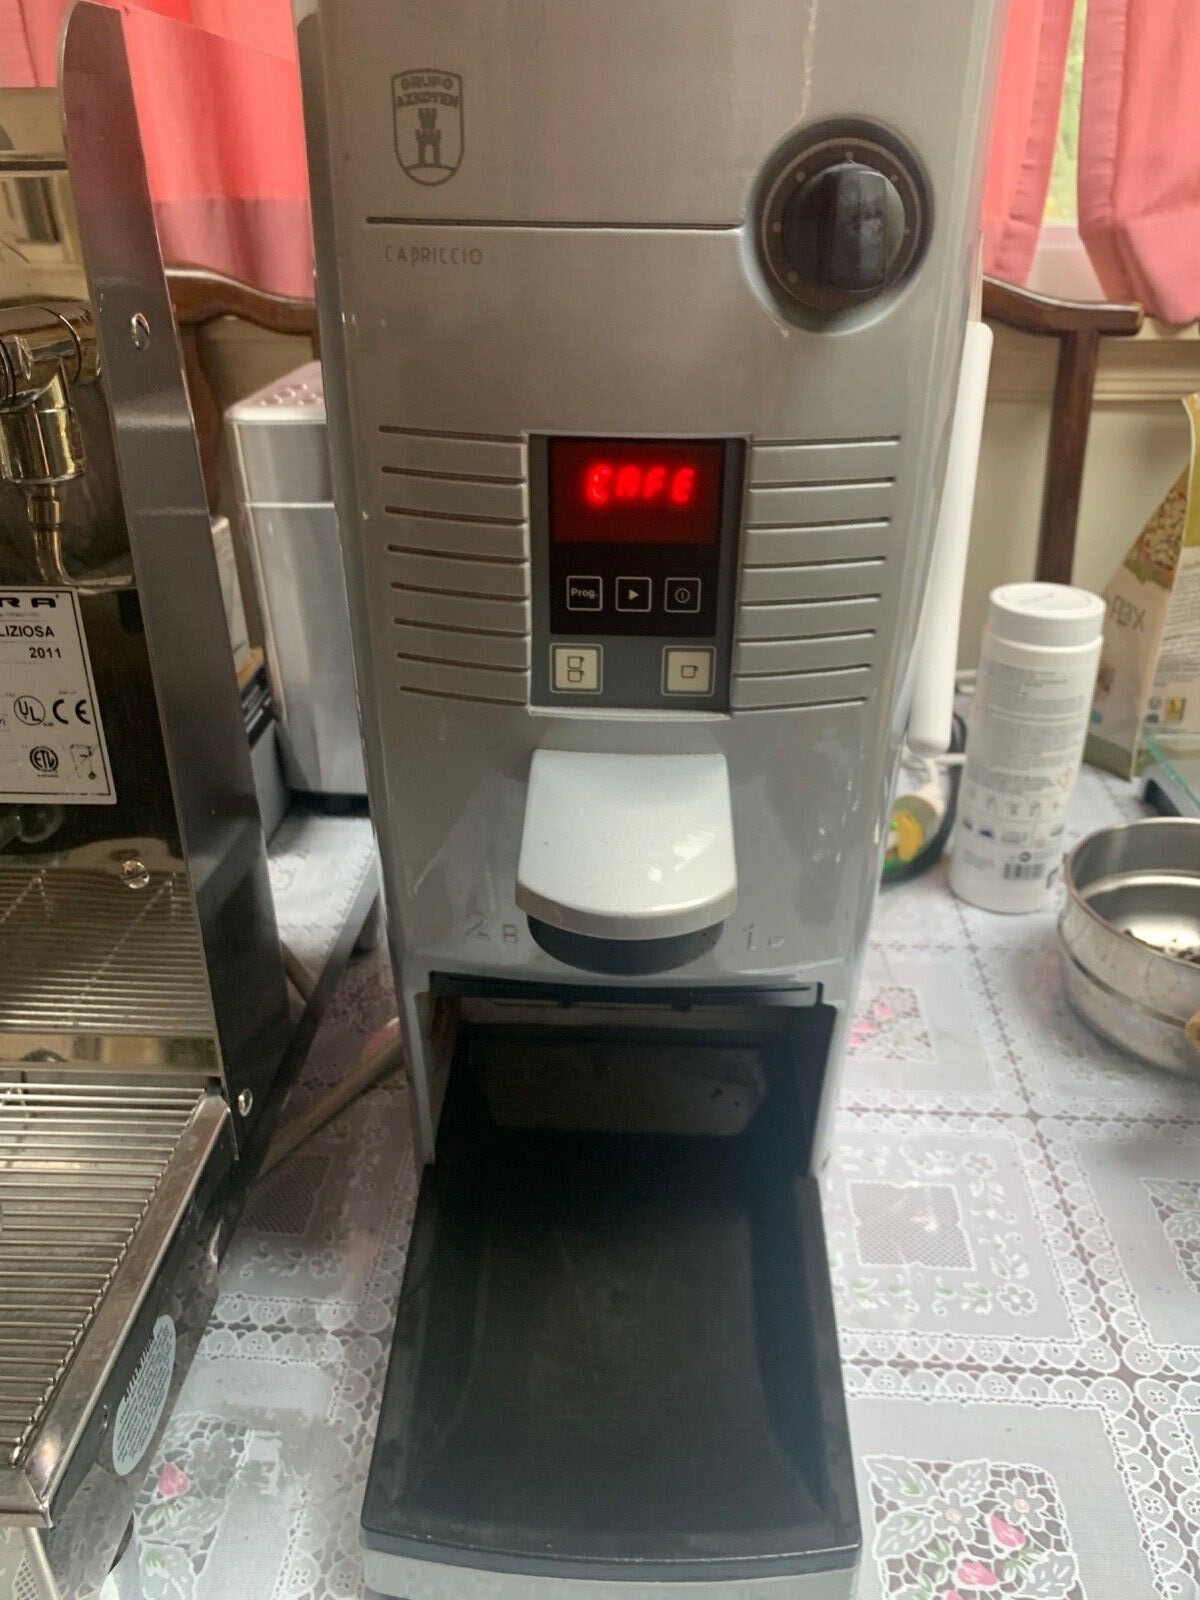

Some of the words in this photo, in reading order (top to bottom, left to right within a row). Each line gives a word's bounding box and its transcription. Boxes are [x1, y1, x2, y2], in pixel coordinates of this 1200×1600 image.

[400, 75, 454, 90] GRUPO
[384, 244, 483, 268] CAPRICCIO
[586, 463, 696, 504] CAFE
[570, 587, 599, 600] Prog.
[29, 646, 62, 659] 2011
[52, 699, 91, 725] CE
